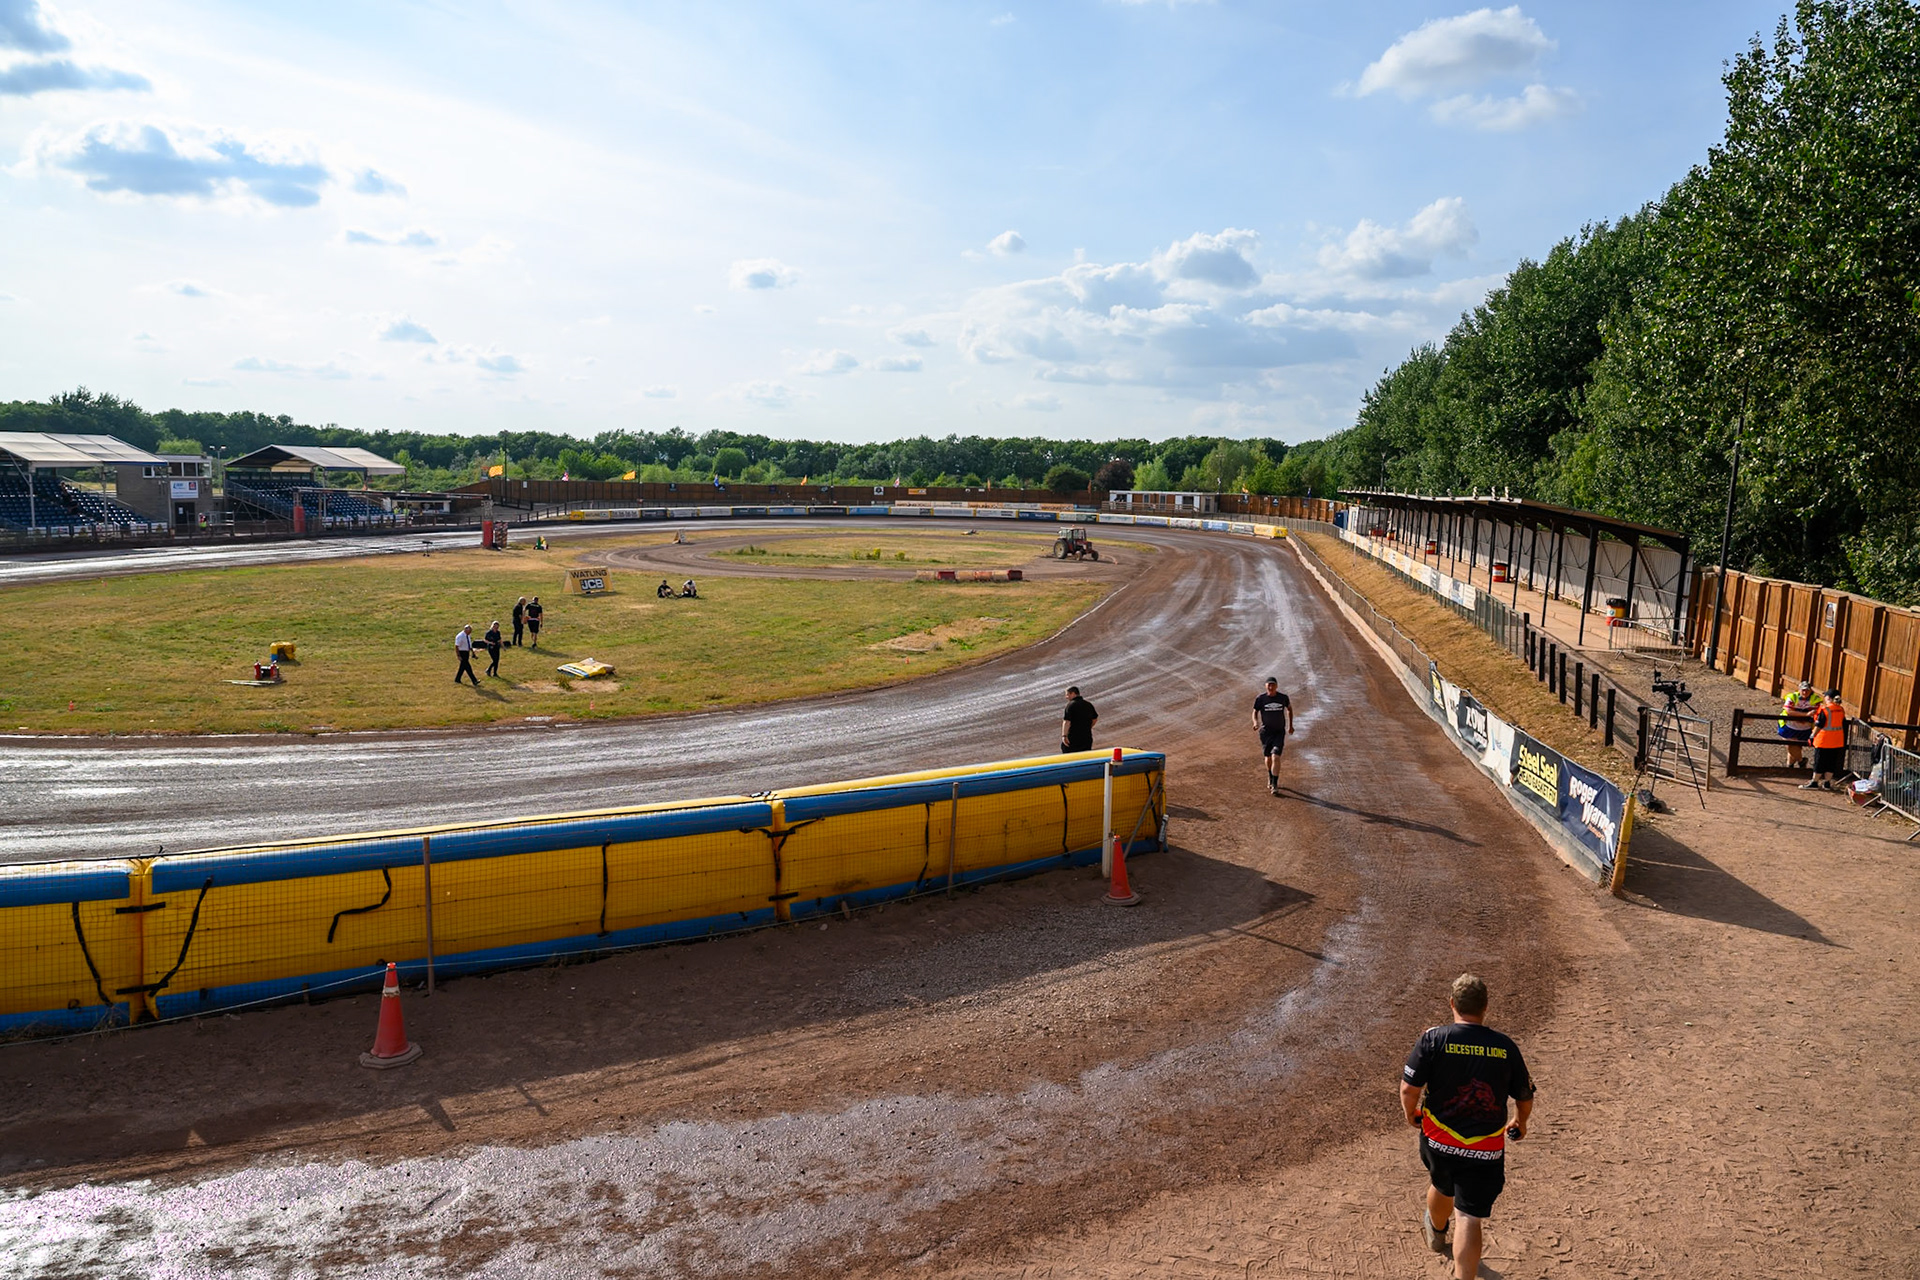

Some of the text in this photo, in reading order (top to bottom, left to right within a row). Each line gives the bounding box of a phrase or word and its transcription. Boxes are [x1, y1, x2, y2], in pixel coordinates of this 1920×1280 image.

[570, 569, 608, 578] WATLING
[581, 578, 604, 590] JCB
[1518, 744, 1540, 776] Steel
[1540, 755, 1558, 787] Seal
[1569, 775, 1598, 804] Roger
[1445, 1043, 1507, 1059] LEICESTER LIONS
[1433, 1142, 1503, 1160] PREMIERSHIP
